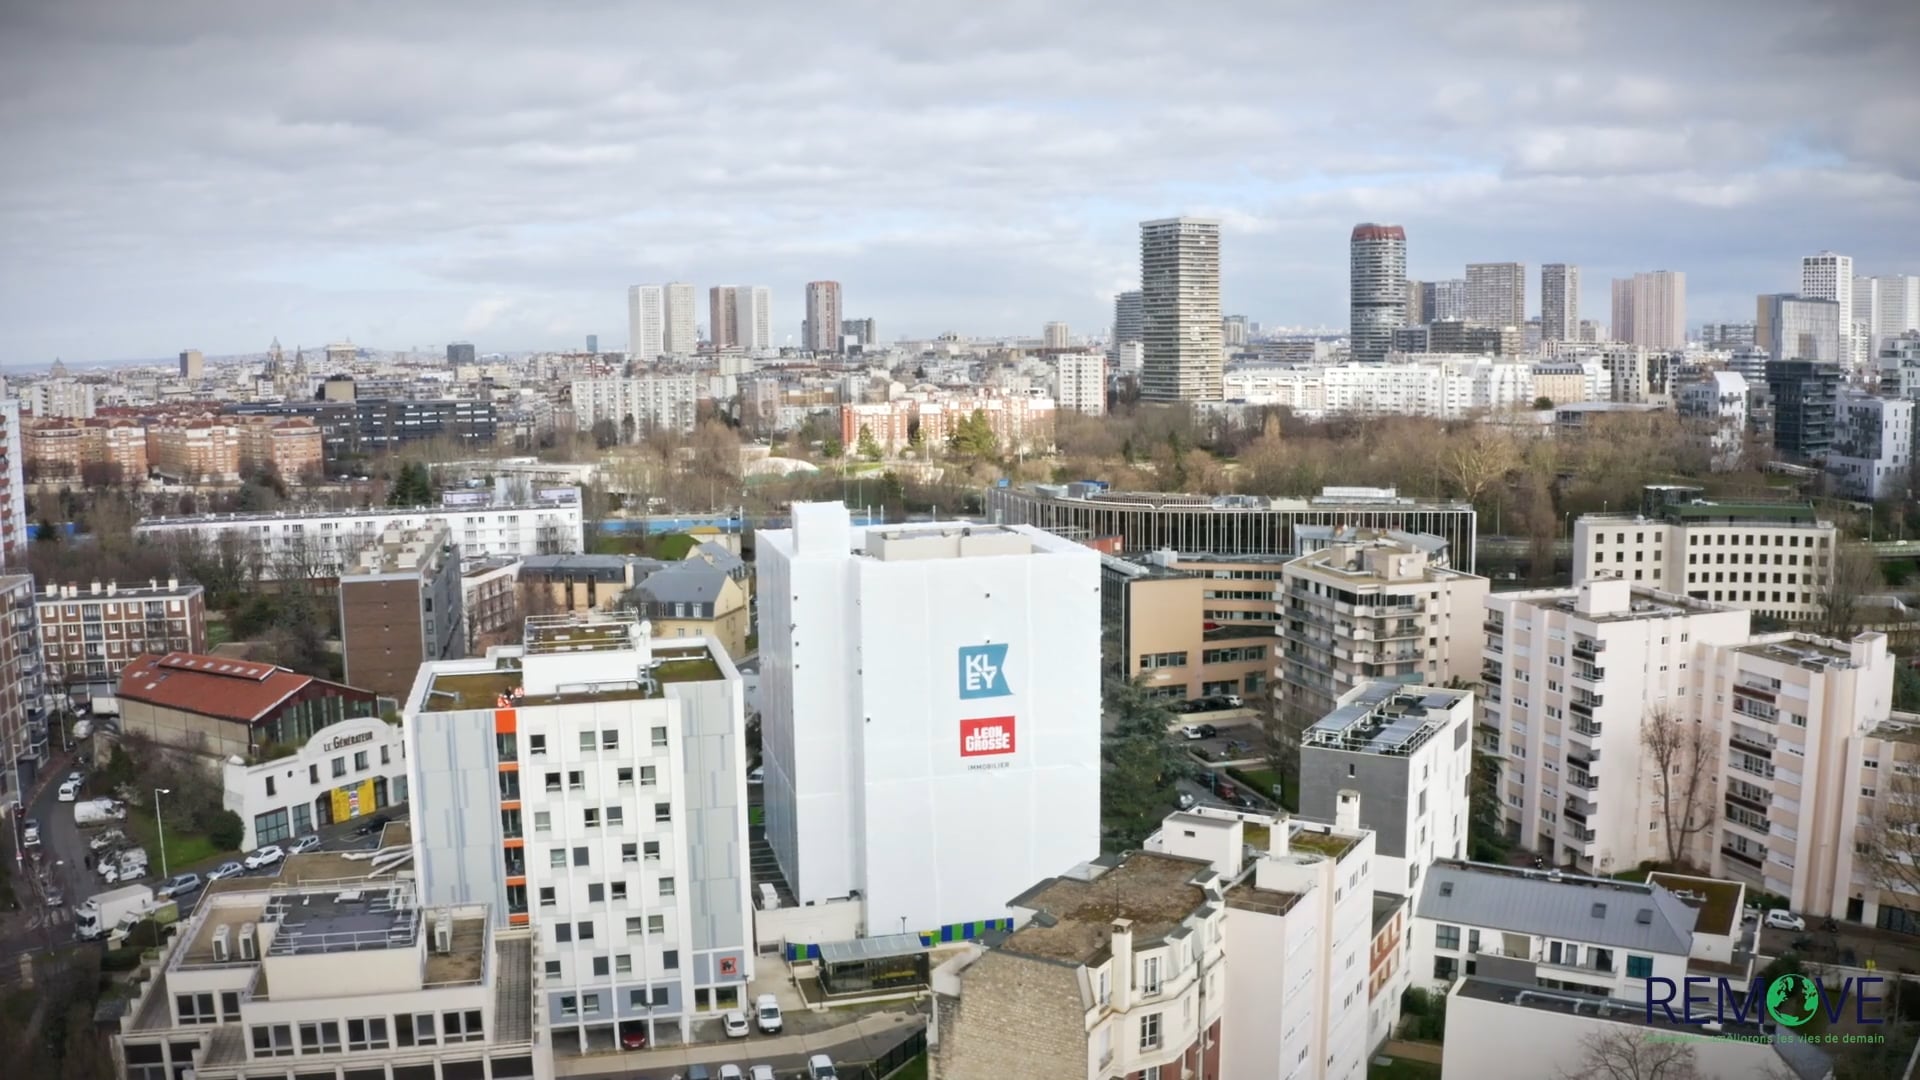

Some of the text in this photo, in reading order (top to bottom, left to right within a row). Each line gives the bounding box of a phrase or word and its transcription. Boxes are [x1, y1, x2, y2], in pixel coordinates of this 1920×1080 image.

[973, 725, 1003, 739] LEON
[965, 732, 1011, 752] GROSSE
[967, 761, 1010, 771] IMMOBILIER
